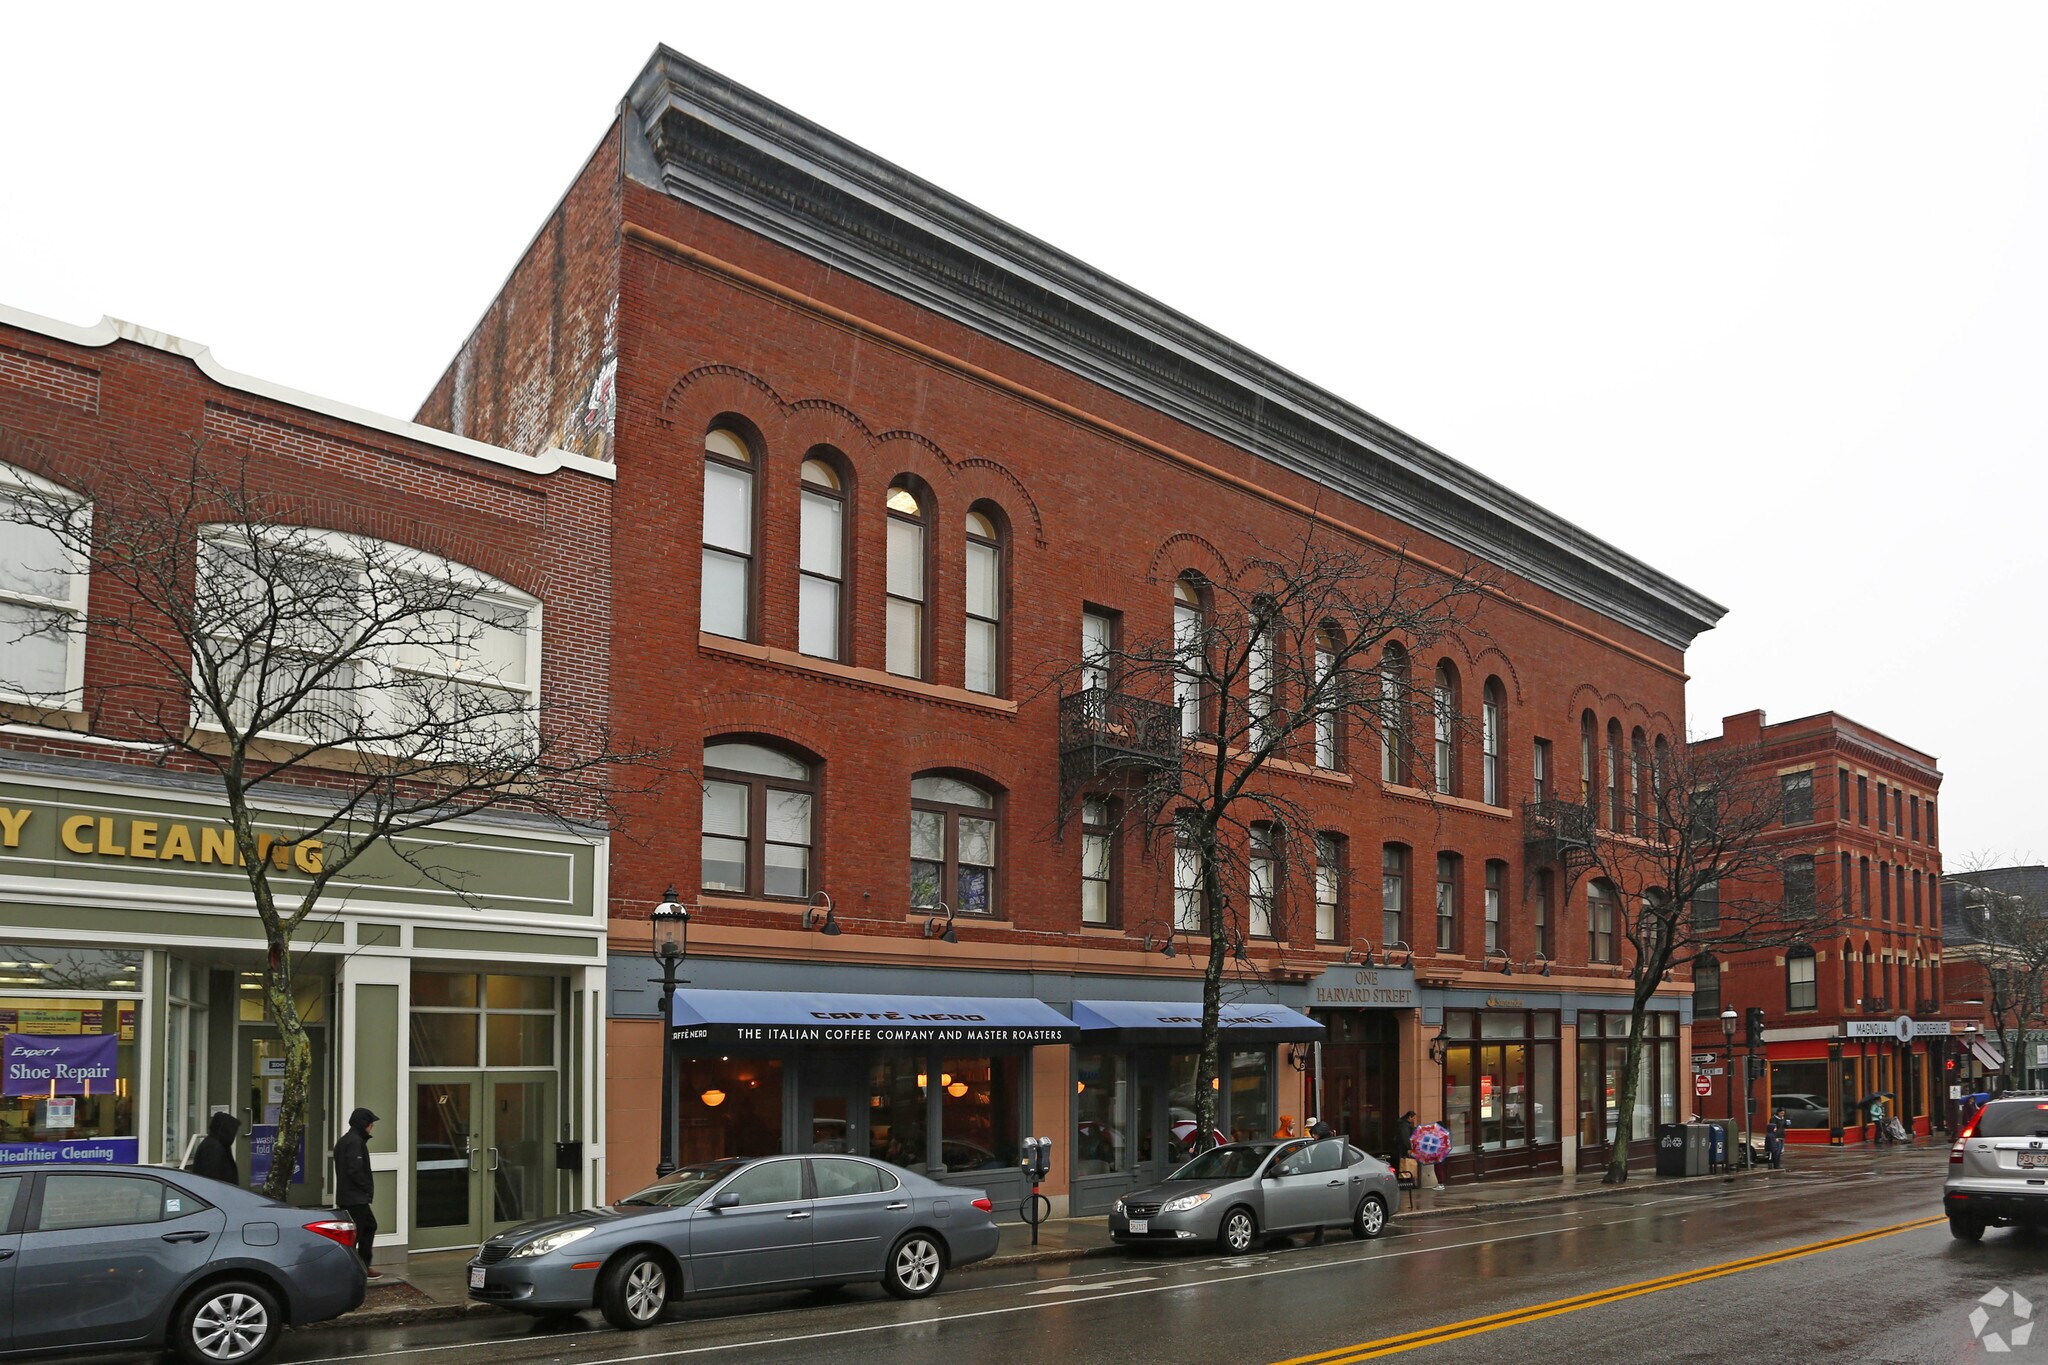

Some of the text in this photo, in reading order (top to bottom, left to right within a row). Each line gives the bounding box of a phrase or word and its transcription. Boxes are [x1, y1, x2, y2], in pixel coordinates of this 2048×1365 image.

[61, 815, 325, 874] CLEANNG
[1355, 971, 1378, 985] ONE
[1316, 987, 1412, 1003] HARVARD STREET
[810, 1012, 986, 1022] CAFFÈ NERO
[1156, 1016, 1204, 1024] CAFF
[672, 1029, 707, 1040] AFFÈ NERO
[738, 1028, 1062, 1040] THE ITALIAN COFFEE COMPANY AND MASTER ROASTERS
[1856, 1023, 1947, 1034] MAGNOLIA SMOKEHOUSE
[11, 1046, 61, 1058] Expert
[10, 1062, 110, 1083] Shoe Repair
[0, 1146, 114, 1162] Healthier Cleaning
[2037, 1155, 2048, 1163] S7
